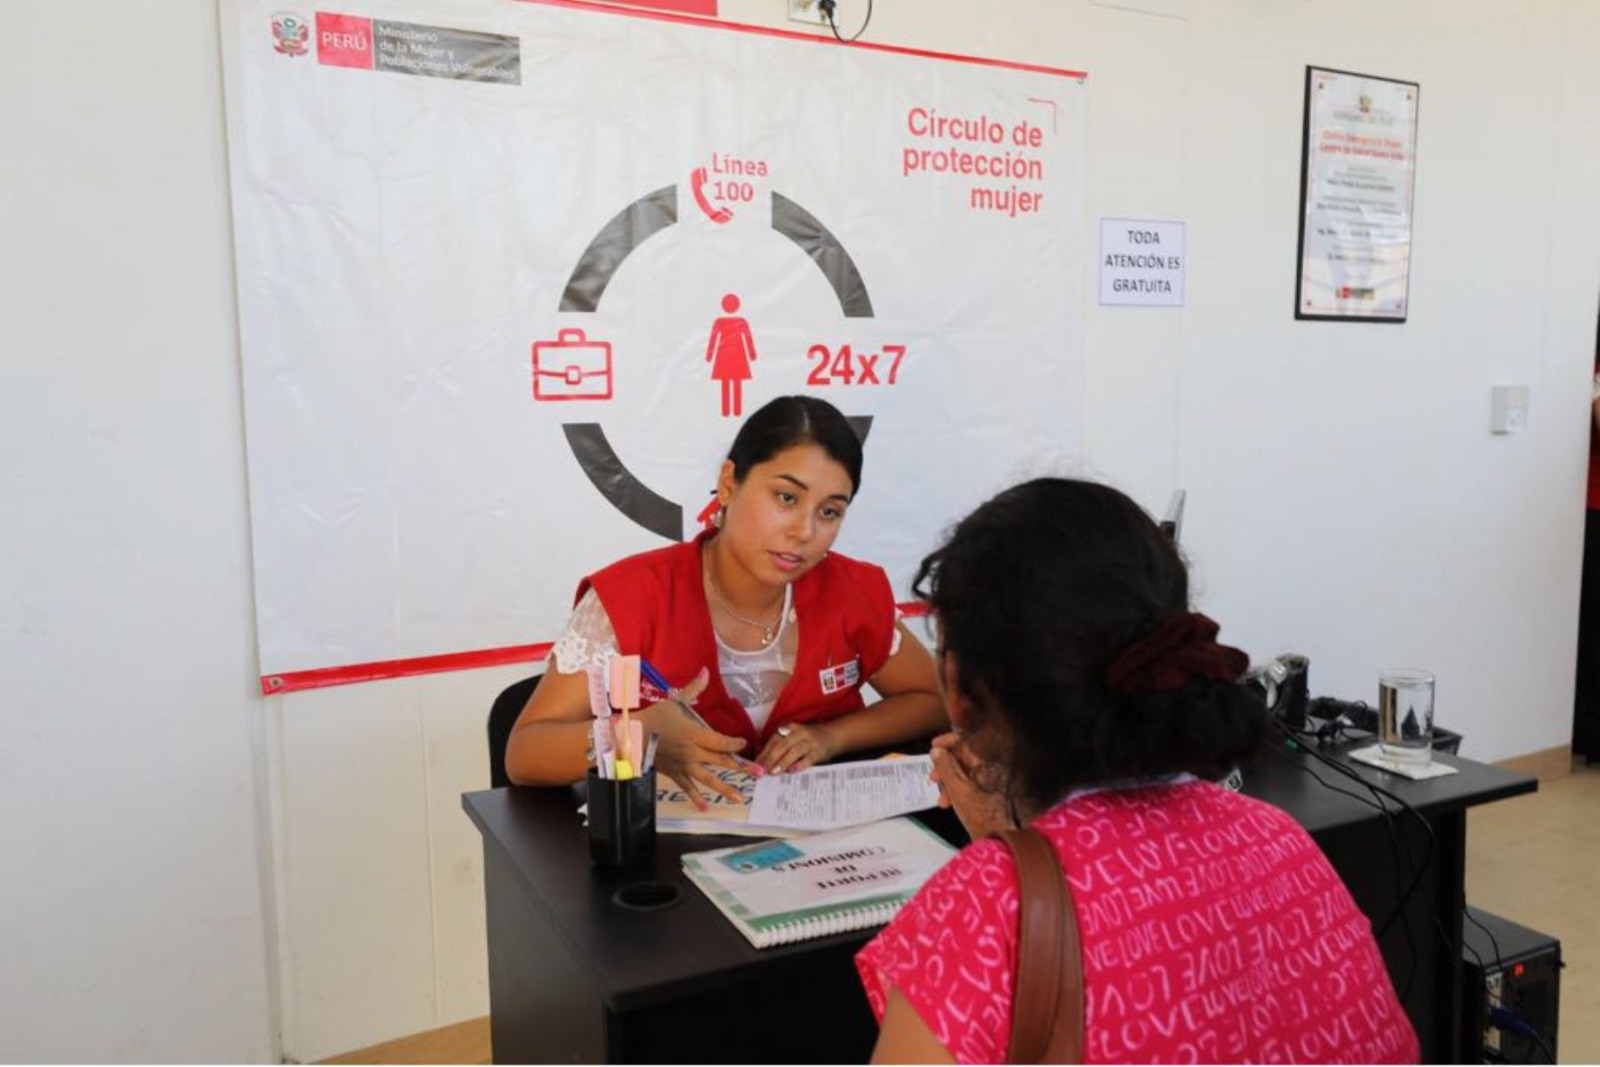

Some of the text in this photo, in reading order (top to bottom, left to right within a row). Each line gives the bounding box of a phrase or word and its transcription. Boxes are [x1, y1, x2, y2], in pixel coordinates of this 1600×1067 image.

[322, 31, 367, 51] PERÚ
[378, 25, 438, 43] Ministerio
[380, 40, 455, 60] de la Mujer y
[379, 53, 449, 73] Poblaciones
[907, 107, 1042, 148] Círculo de
[711, 152, 769, 178] Línea
[903, 146, 1042, 181] protección
[713, 181, 754, 202] 100
[970, 184, 1043, 218] mujer
[1128, 230, 1161, 244] TODA
[1104, 252, 1180, 270] ATENCIÓN ES
[1113, 279, 1171, 294] GRATUITA
[806, 343, 906, 386] 24x7
[1160, 897, 1236, 951] LOVE
[1177, 935, 1245, 993] LOVE
[1100, 993, 1206, 1059] LOVE
